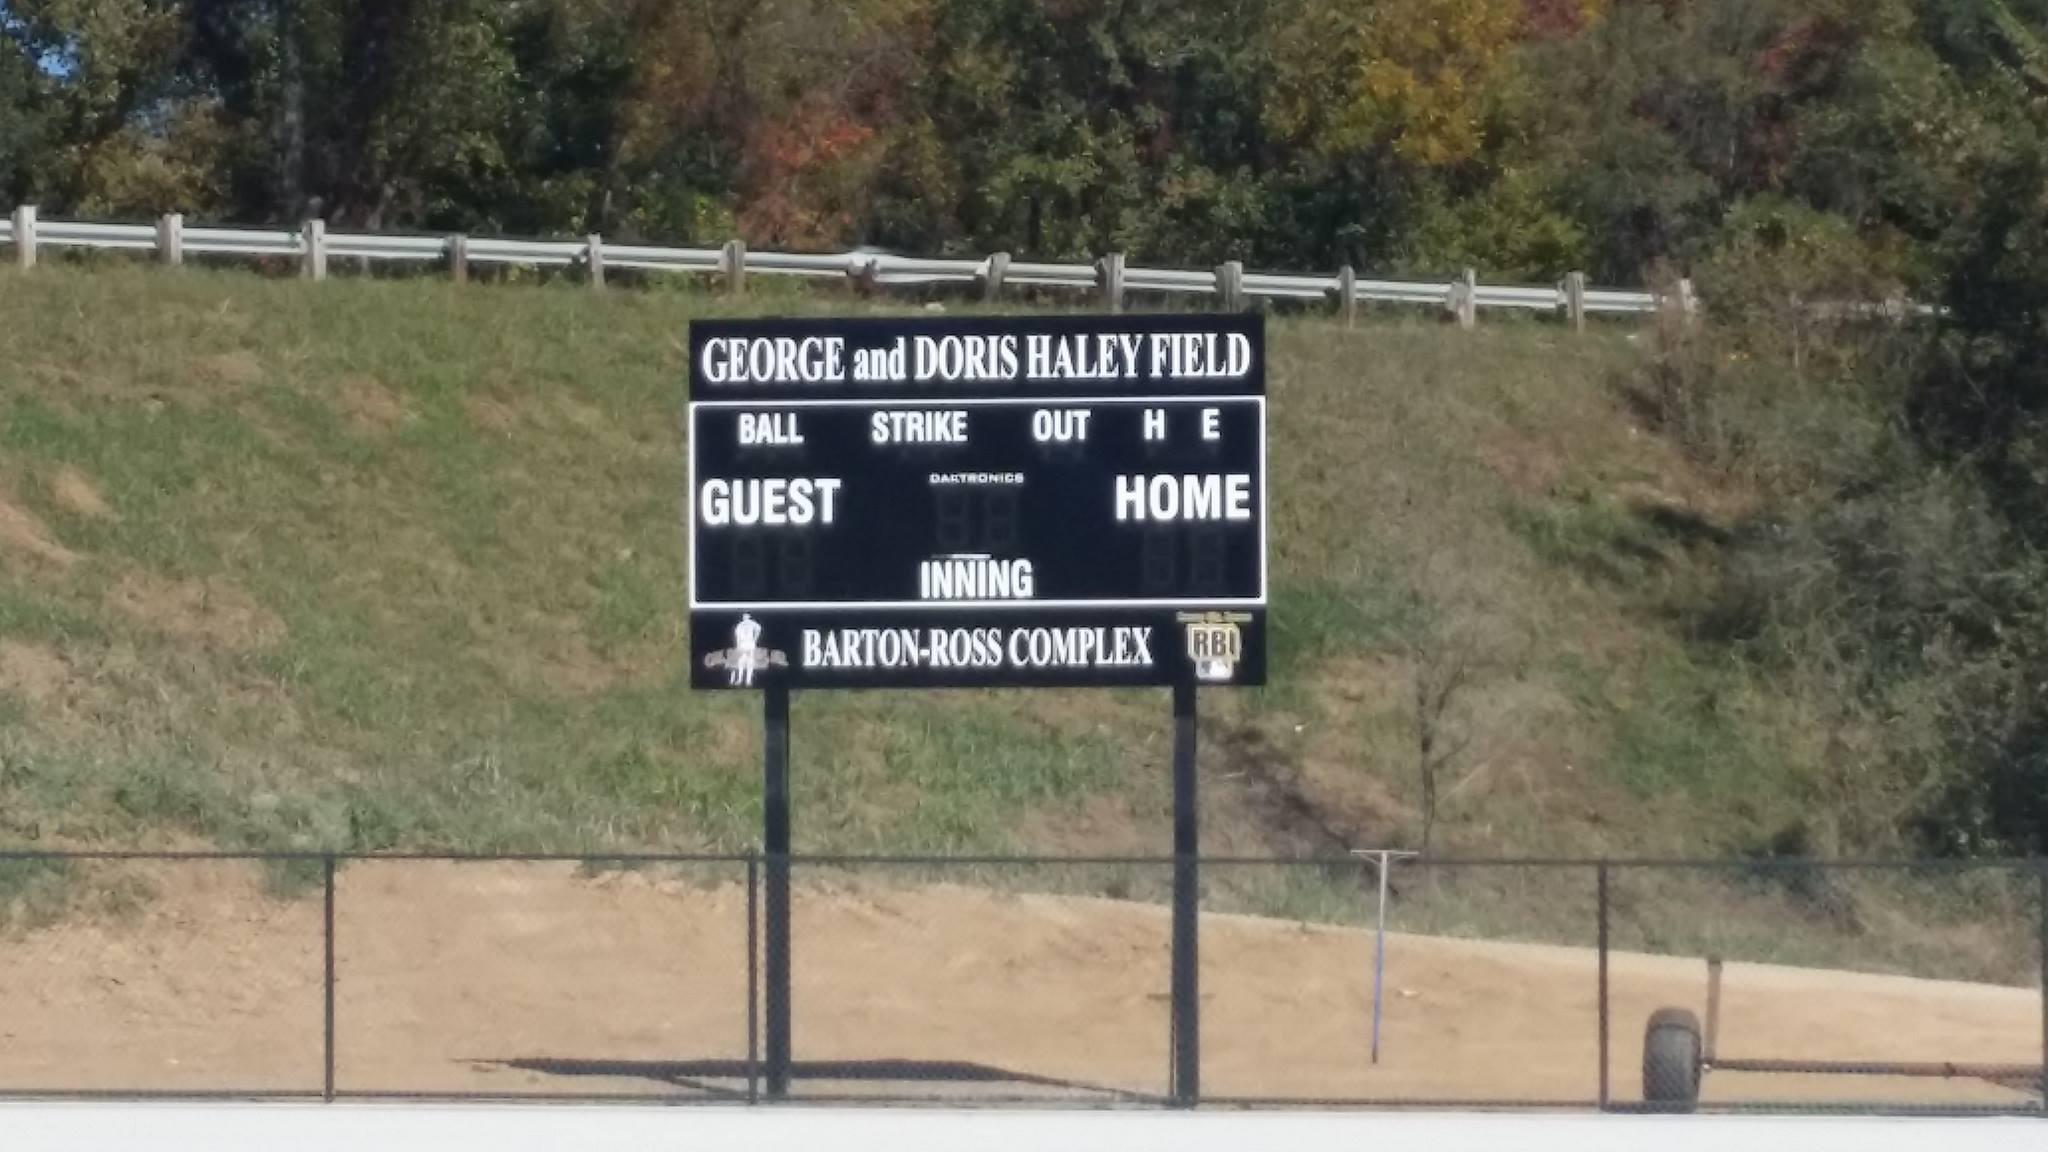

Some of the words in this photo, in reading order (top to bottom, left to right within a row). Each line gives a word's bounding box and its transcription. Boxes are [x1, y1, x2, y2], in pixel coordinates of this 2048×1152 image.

[702, 337, 845, 383] GEORGE
[853, 337, 906, 381] and
[914, 335, 1018, 381] DORIS
[1026, 334, 1143, 379] HALEY
[1150, 333, 1250, 378] FIELD
[738, 413, 804, 445] BALL
[872, 411, 967, 444] STRIKE
[1033, 409, 1091, 442] OUT
[1144, 409, 1165, 440] H
[1202, 409, 1220, 440] E
[701, 478, 841, 527] GUEST
[1116, 474, 1250, 522] HOME
[921, 559, 1033, 598] INNING
[803, 628, 1003, 668] BARTON-ROSS
[1008, 627, 1152, 667] COMPLEX
[1193, 628, 1236, 657] RBI
